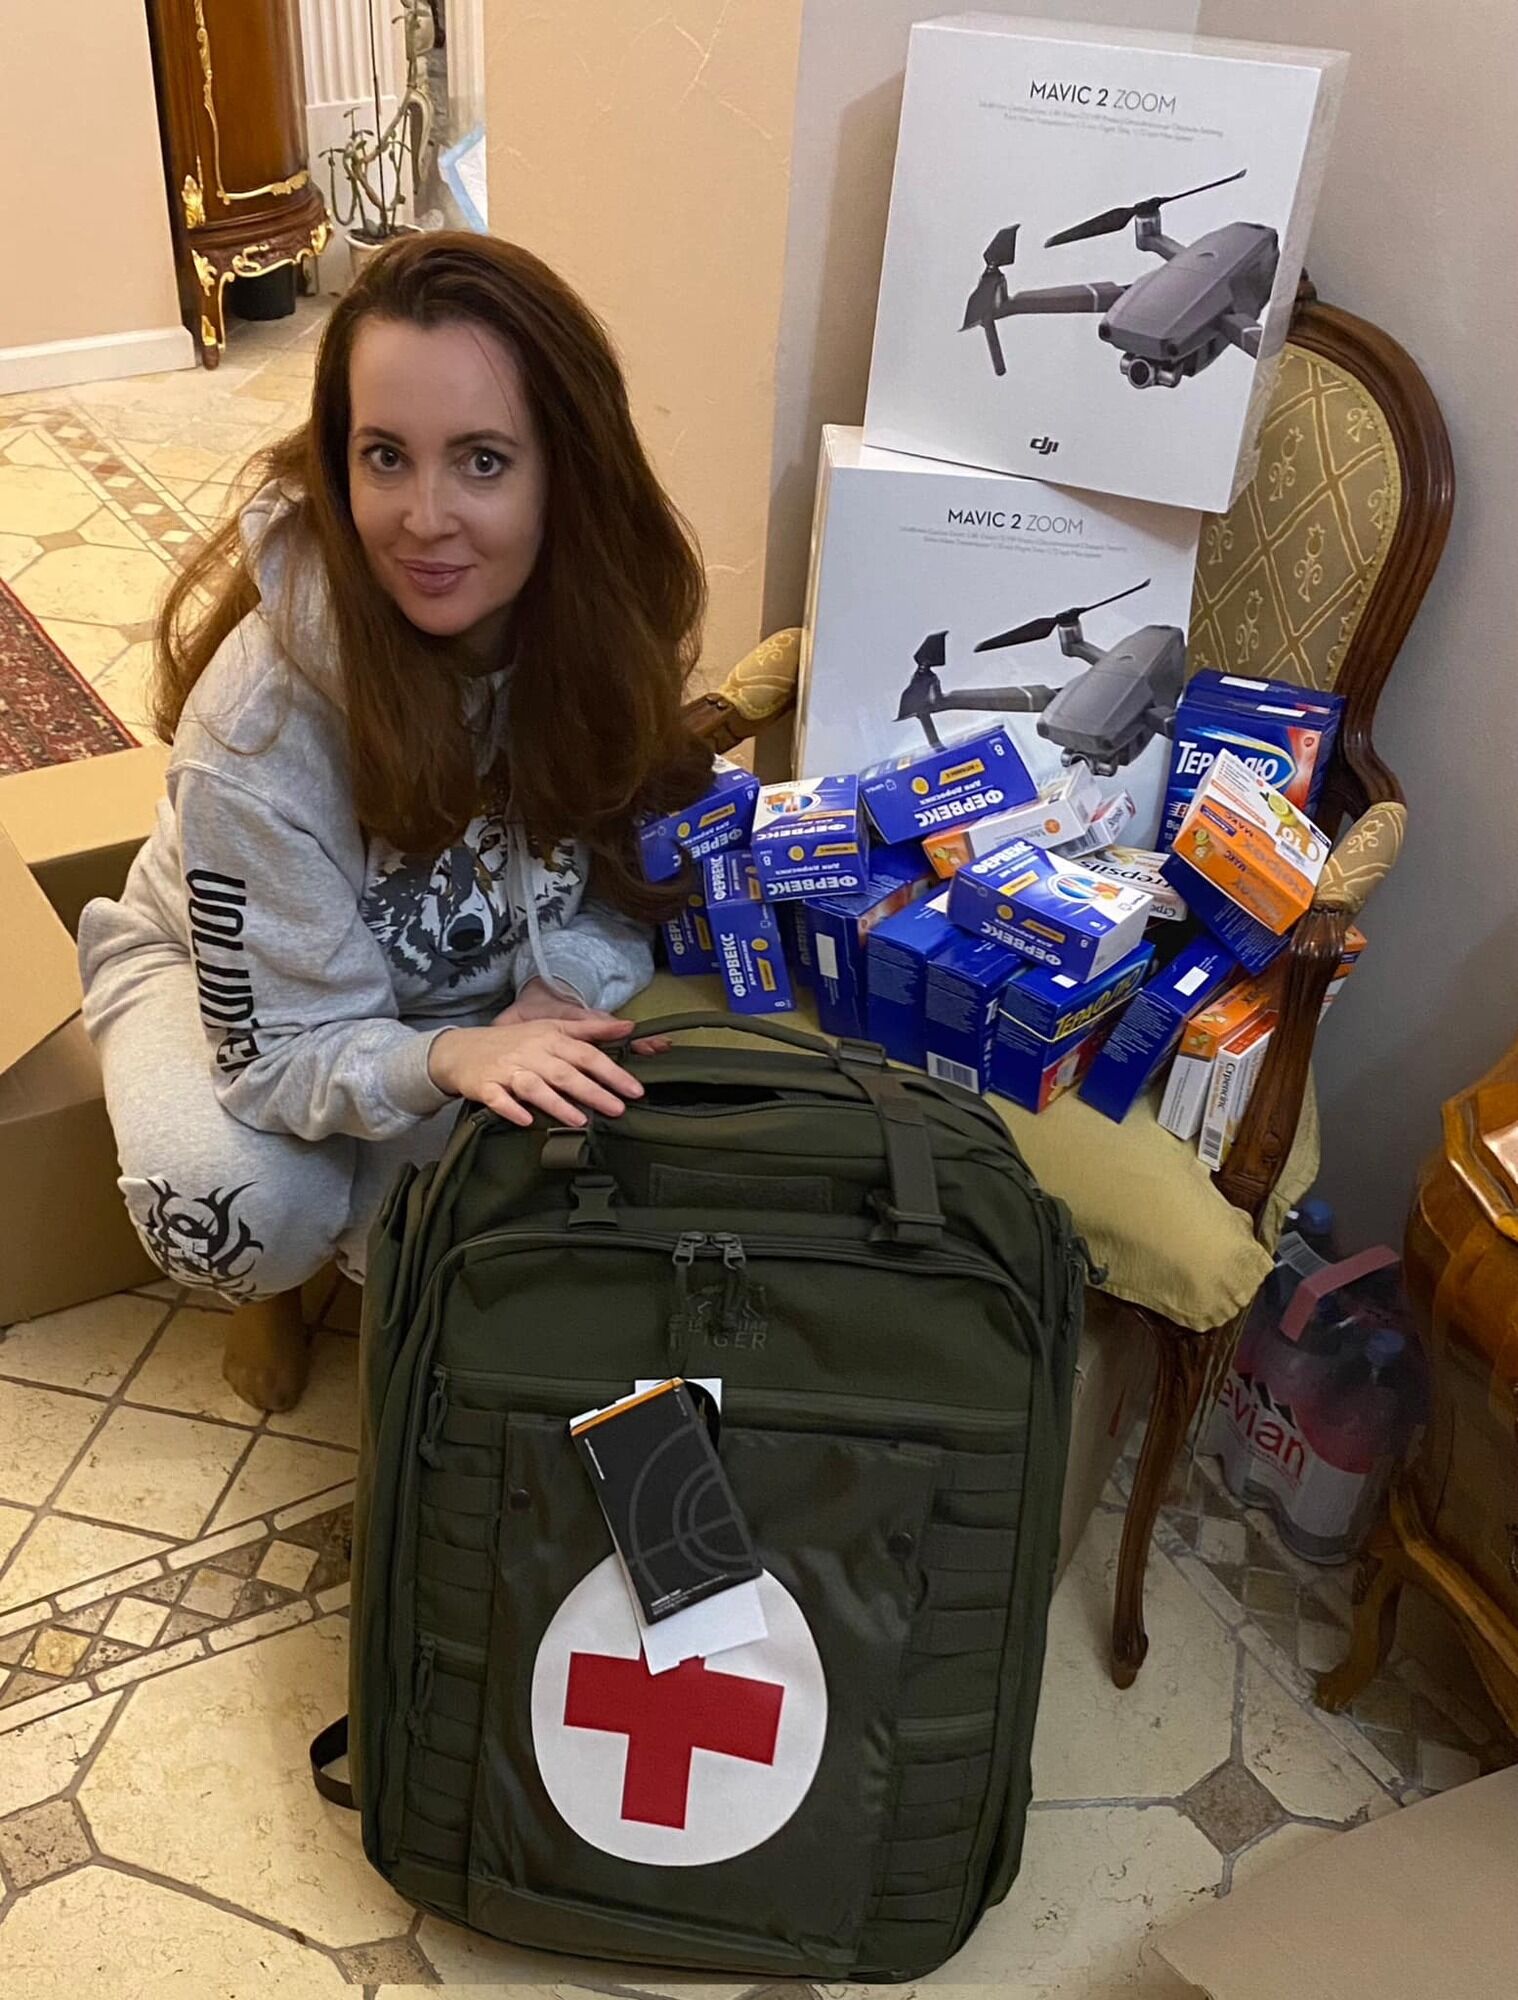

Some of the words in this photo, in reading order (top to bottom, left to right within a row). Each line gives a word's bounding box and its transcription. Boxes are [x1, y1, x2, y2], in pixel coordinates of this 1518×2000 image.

[1030, 80, 1092, 105] MAVIC
[1096, 88, 1109, 107] 2
[1113, 89, 1177, 114] ZOOM
[948, 508, 1006, 529] MAVIC
[1010, 513, 1022, 530] 2
[1026, 514, 1084, 535] ZOOM
[994, 744, 1005, 756] 8
[914, 789, 1004, 827] ФЕРВЕКС
[672, 828, 743, 868] ФЕРВЕС
[763, 856, 771, 866] 8
[710, 855, 727, 900] ФЕРВЕКС
[766, 875, 858, 895] ФЕРВЕКС
[1081, 859, 1172, 888] trepsils
[981, 921, 1062, 966] ФЕРВЕКС
[720, 933, 746, 997] ФЕРВЕКС
